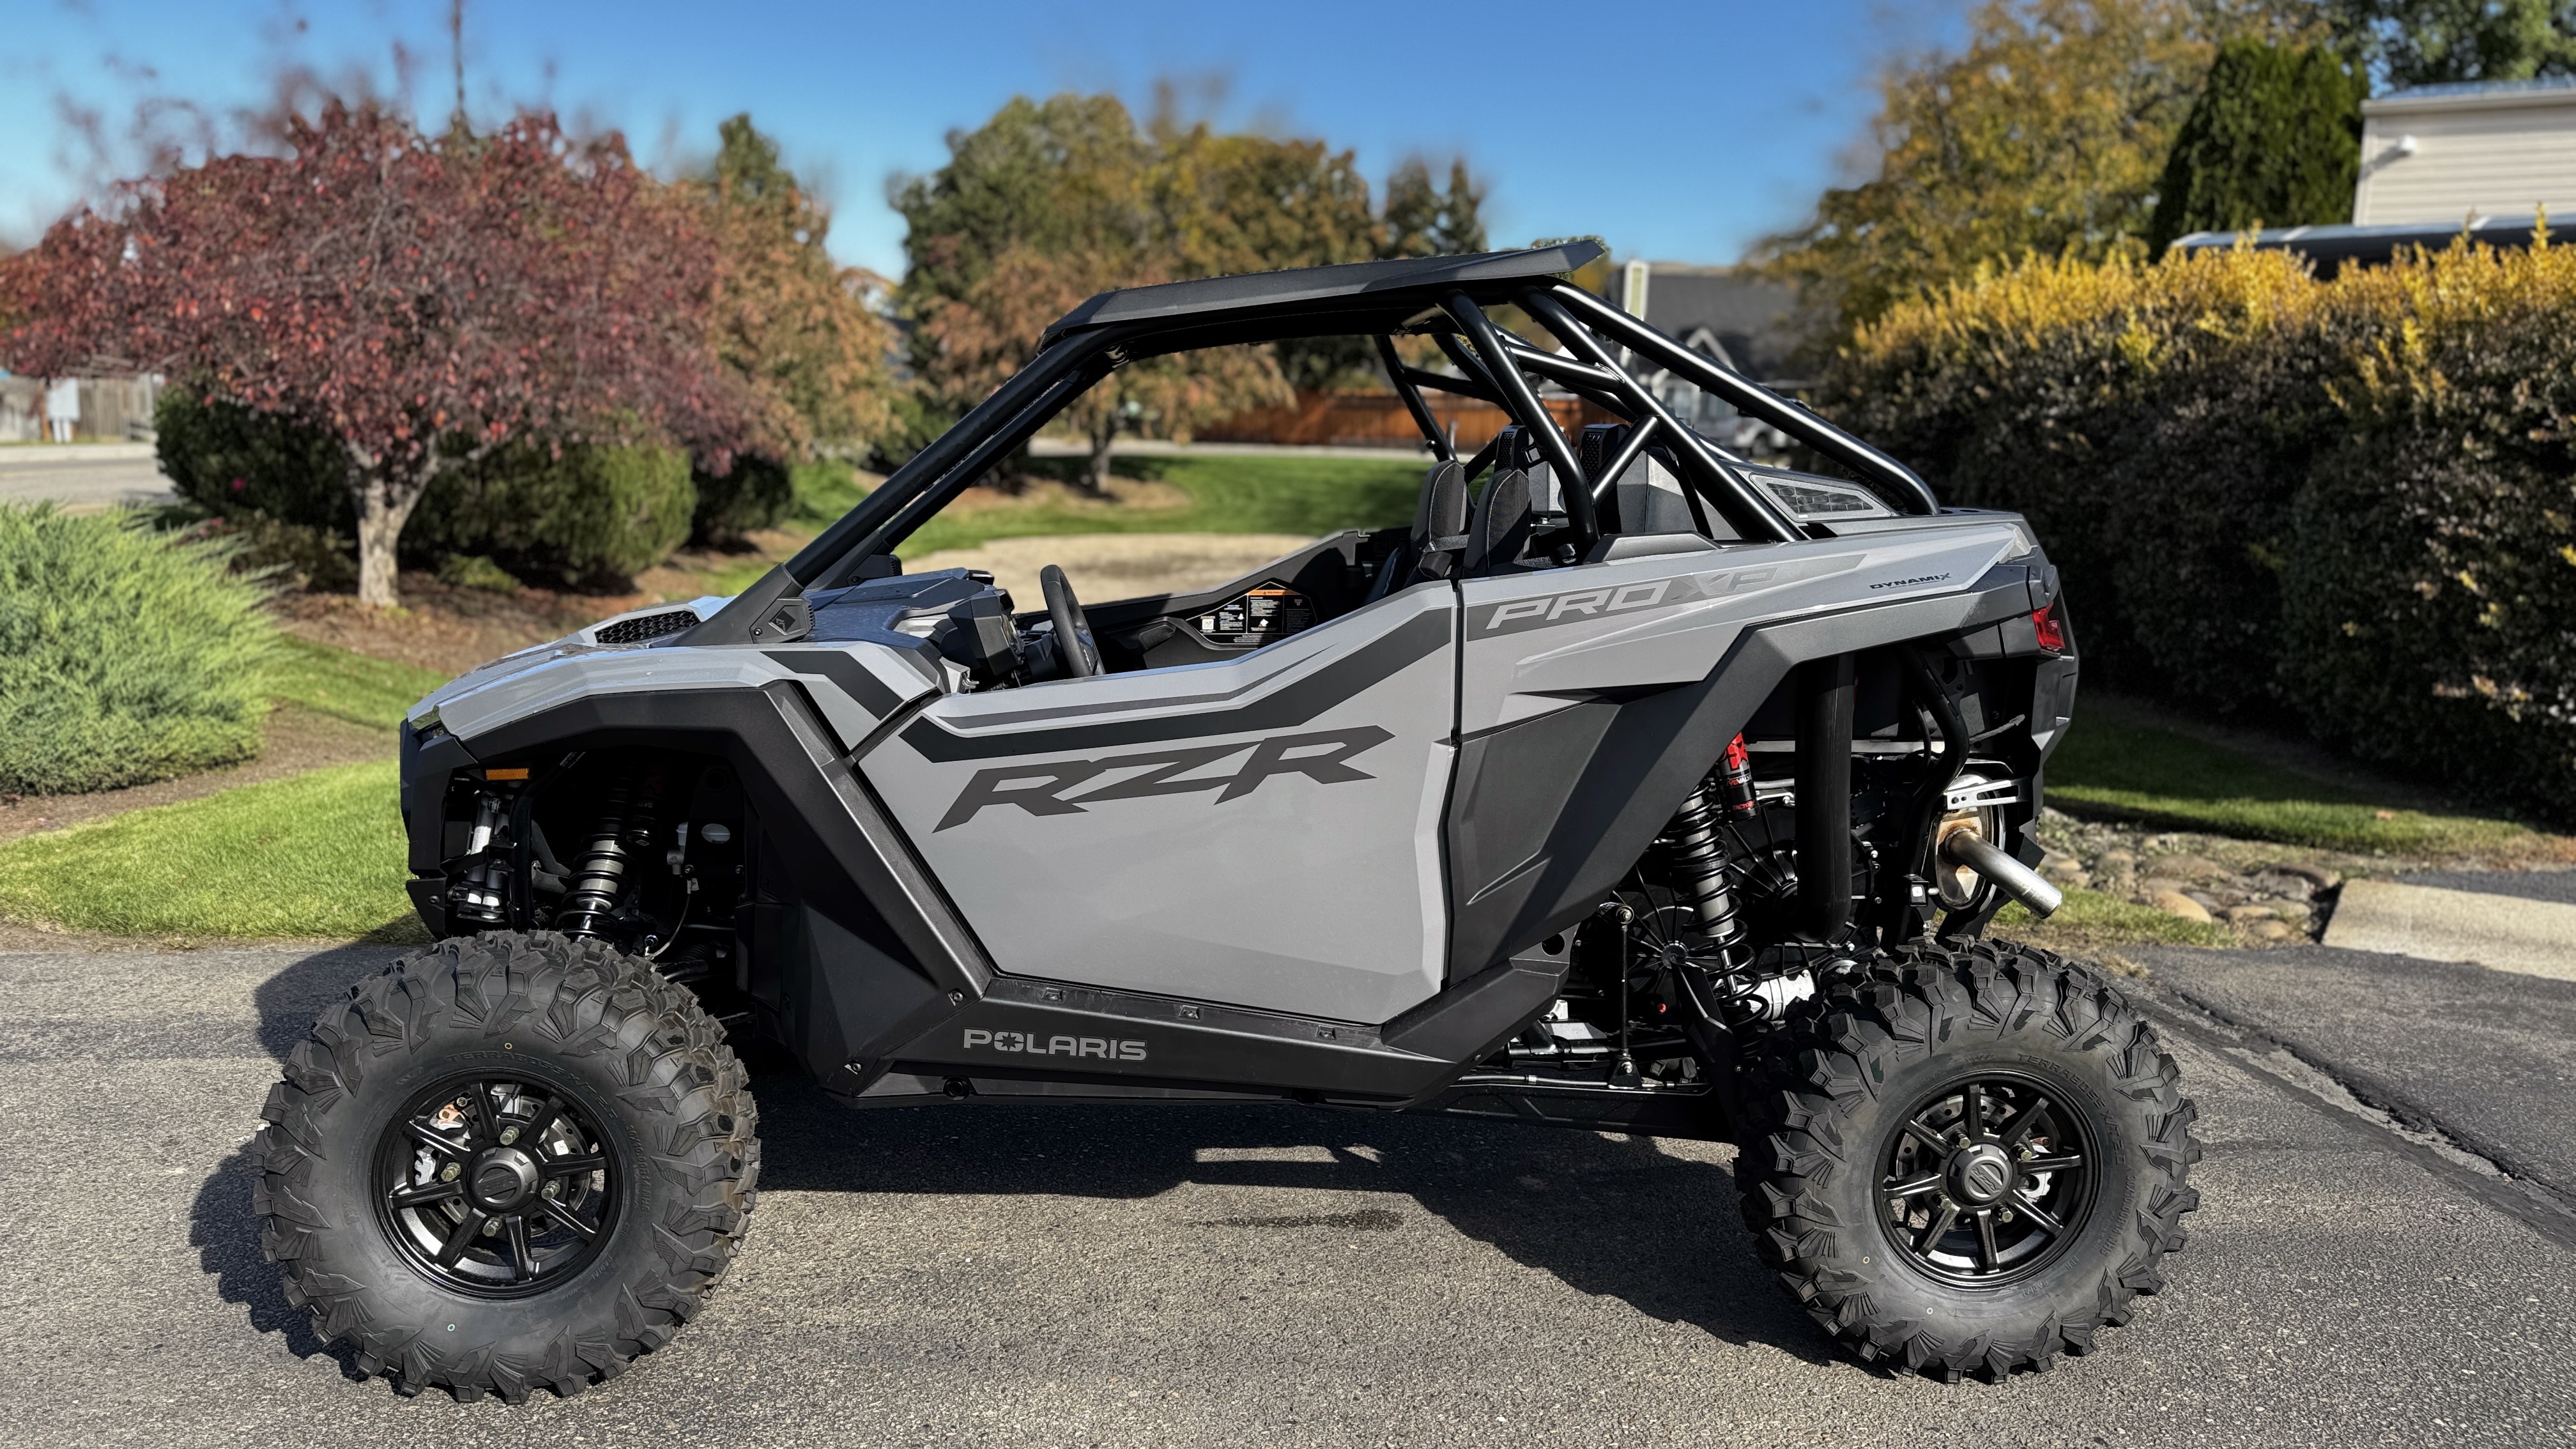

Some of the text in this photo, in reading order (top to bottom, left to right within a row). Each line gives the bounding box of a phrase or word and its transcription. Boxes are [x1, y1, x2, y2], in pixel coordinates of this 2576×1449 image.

[1486, 567, 1779, 630] PRO XP
[1869, 572, 1952, 590] DYNAMIX
[931, 725, 1396, 834] RZR
[963, 1028, 1147, 1061] POLARIS
